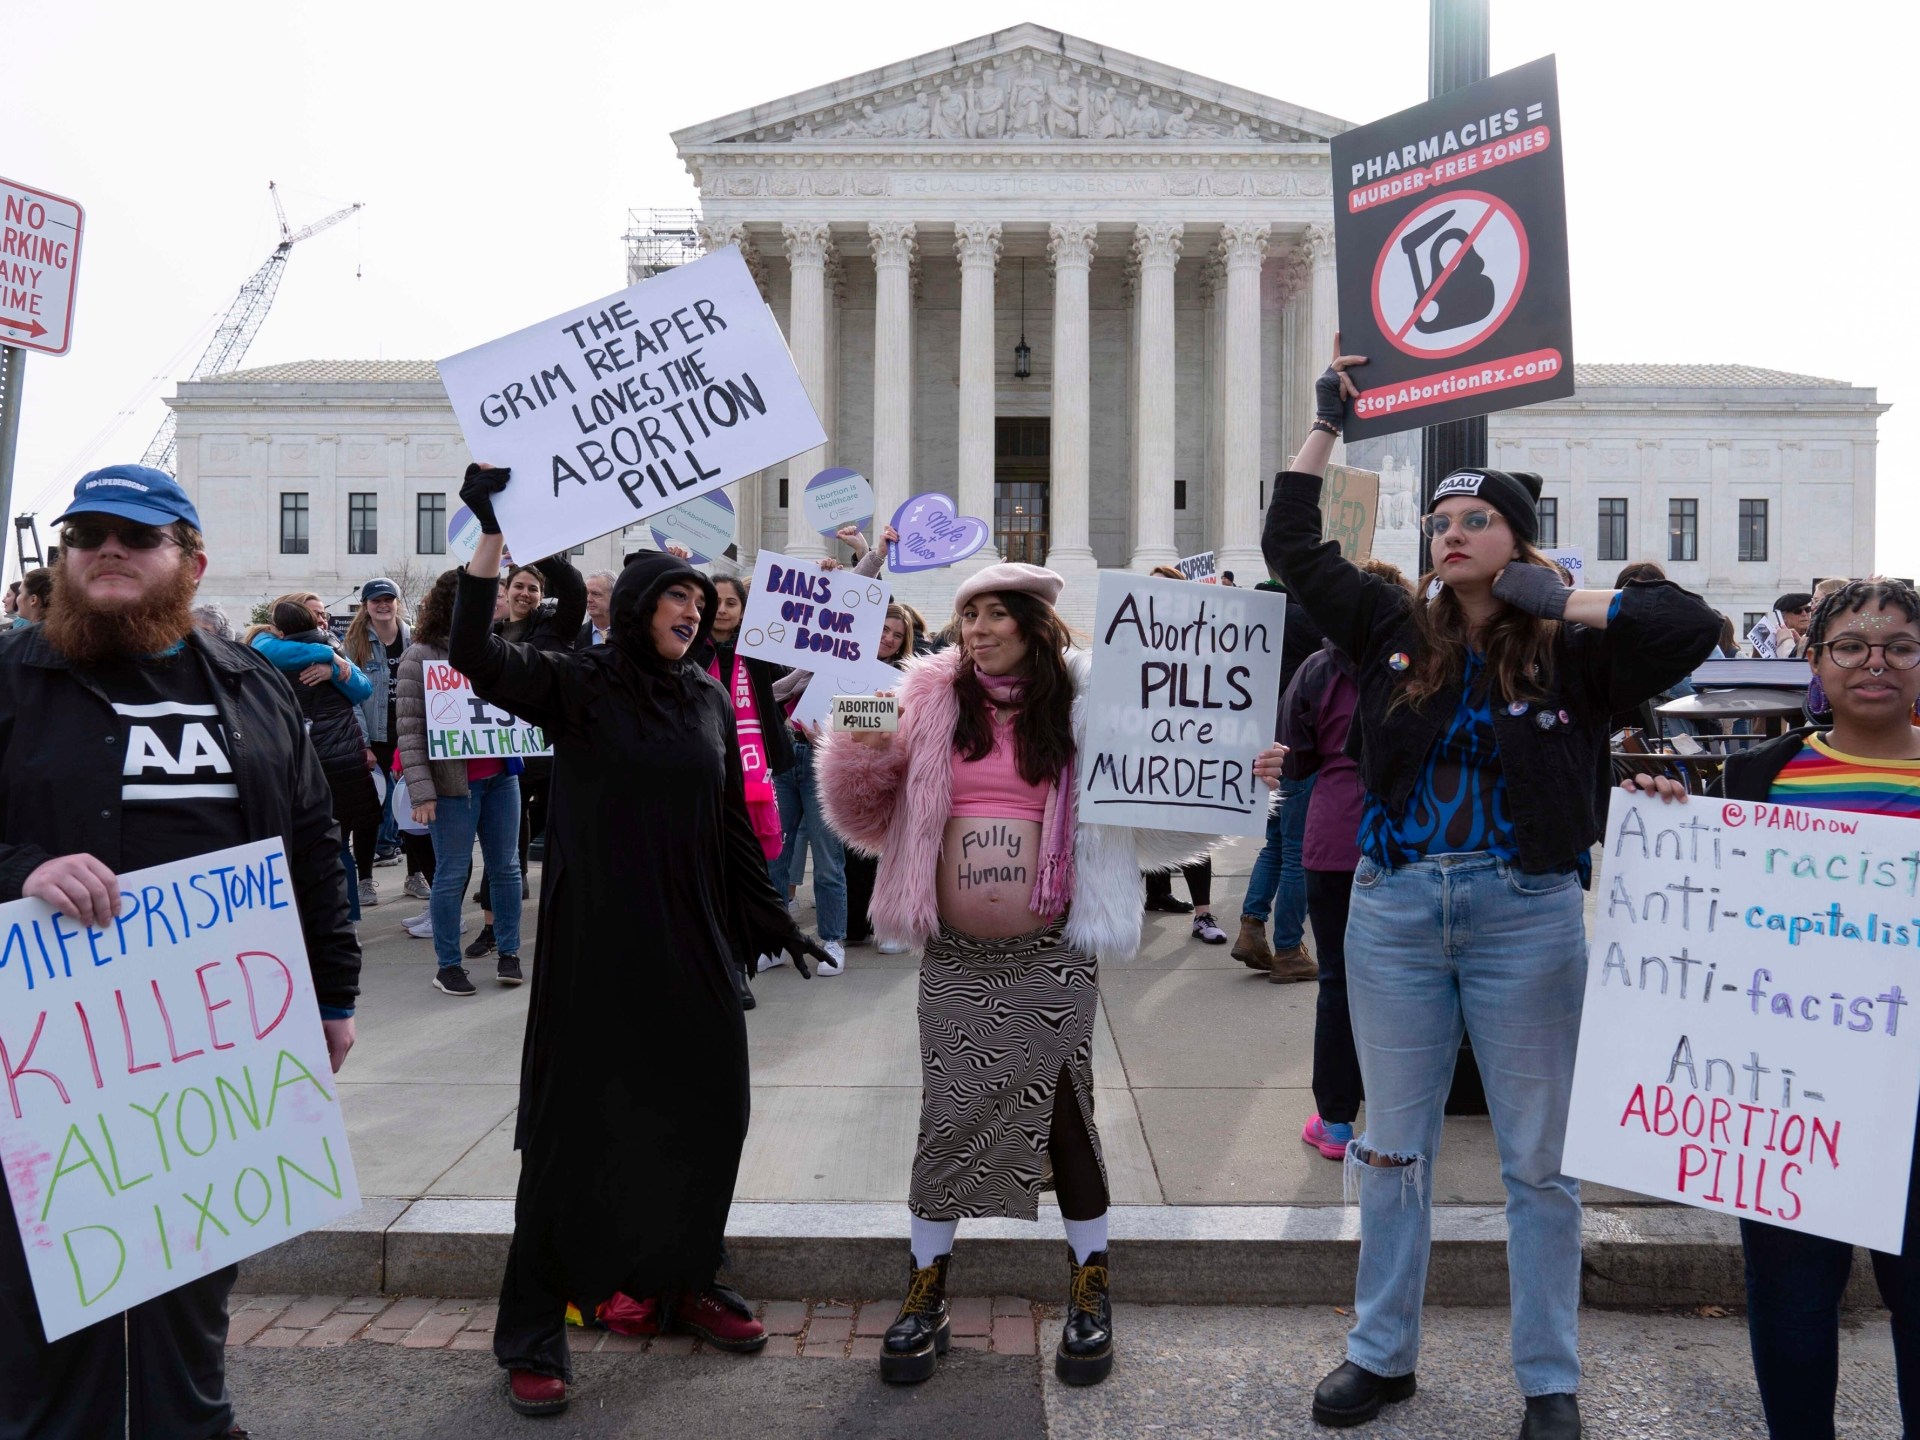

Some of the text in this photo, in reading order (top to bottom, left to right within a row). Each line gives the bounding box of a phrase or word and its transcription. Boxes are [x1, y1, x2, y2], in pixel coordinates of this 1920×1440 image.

[1351, 108, 1520, 185] PHARMACIES
[1353, 130, 1545, 208] MURDER-FREE ZONES
[5, 194, 46, 230] NO
[0, 226, 68, 269] RKING
[562, 300, 639, 349] THE
[480, 298, 727, 428] GRIM REAPER
[1356, 356, 1557, 413] StopAbortionRx.com
[571, 347, 715, 434] LOVES THE
[552, 372, 767, 498] ABORTION
[618, 449, 721, 509] PILL
[815, 486, 849, 502] Abortion
[817, 493, 859, 510] Healthcare
[1437, 477, 1479, 493] PAAU
[925, 511, 966, 542] Mife
[766, 563, 832, 605] BANS
[1182, 554, 1215, 580] SUPREME
[1557, 557, 1582, 569] 980s
[781, 600, 855, 634] OFF OUR
[1104, 591, 1271, 657] Abortion
[794, 627, 861, 662] BODIES
[838, 701, 894, 713] ABORTION
[1141, 661, 1253, 711] PILLS
[1151, 718, 1213, 744] are
[1087, 752, 1257, 805] MURDER!
[961, 825, 1022, 860] Fully
[957, 862, 1027, 890] Human
[0, 951, 294, 1119] KILLED
[1665, 1034, 1826, 1109] Anti-
[41, 1049, 332, 1222] ALYONA
[1619, 1083, 1842, 1169] ABORTION
[1677, 1143, 1803, 1222] PILLS
[62, 1136, 342, 1307] DIXON
